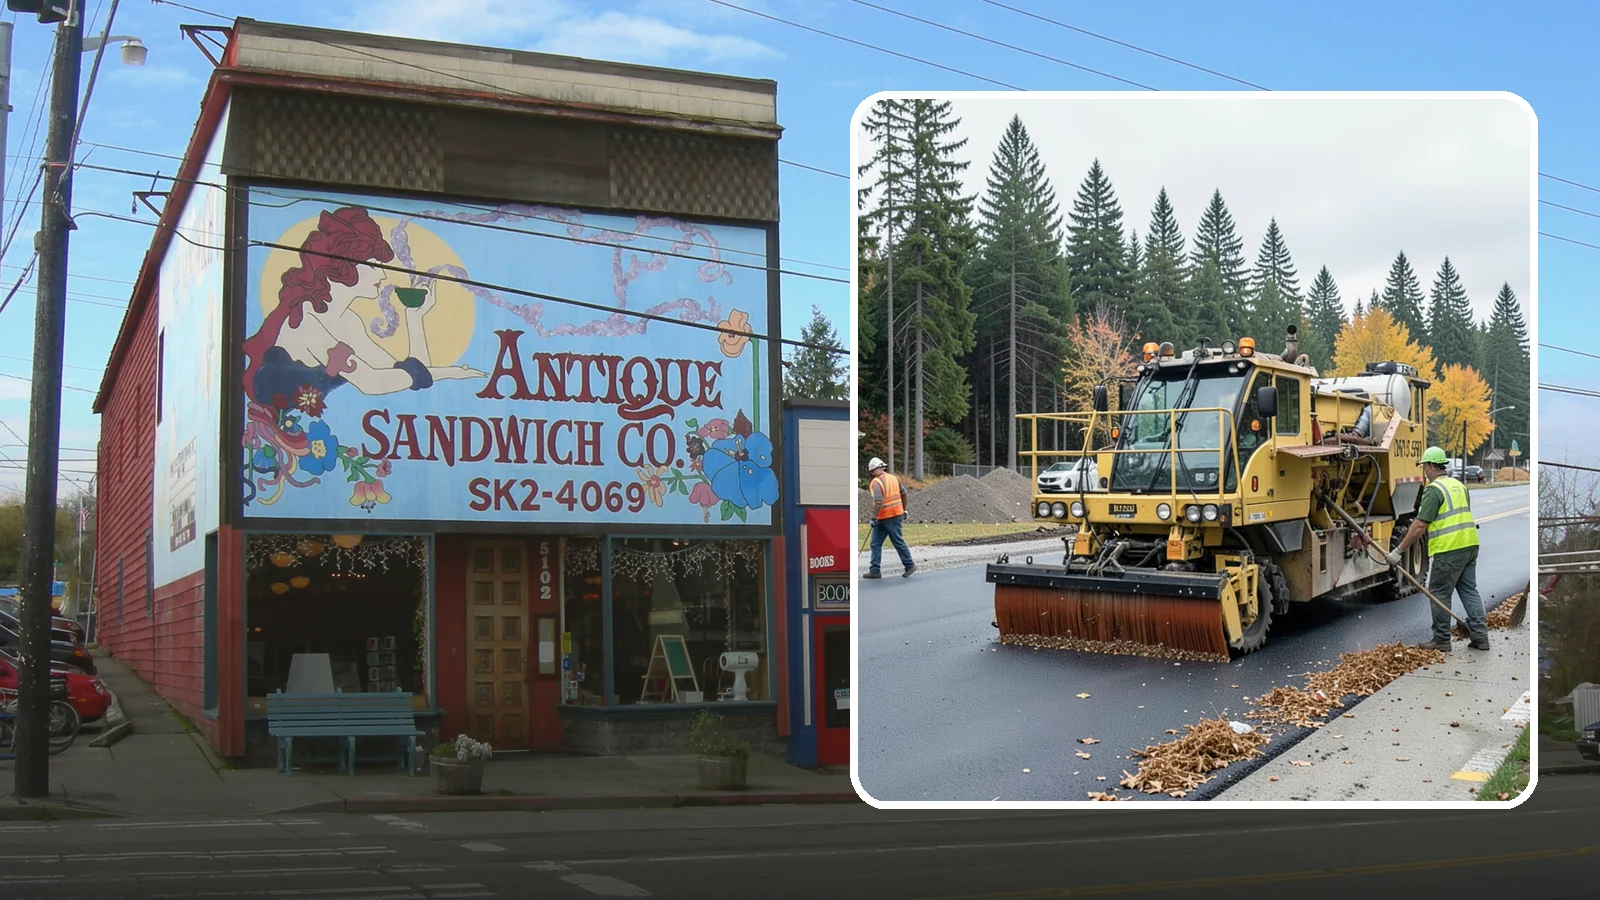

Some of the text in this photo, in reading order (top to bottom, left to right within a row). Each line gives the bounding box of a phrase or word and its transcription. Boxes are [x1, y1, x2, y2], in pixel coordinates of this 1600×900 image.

[475, 329, 724, 421] ANTIQUE
[360, 408, 686, 469] SANDWICH CO.
[468, 477, 646, 513] SK2-4069
[540, 542, 551, 599] 5102
[809, 555, 835, 569] BOOKS
